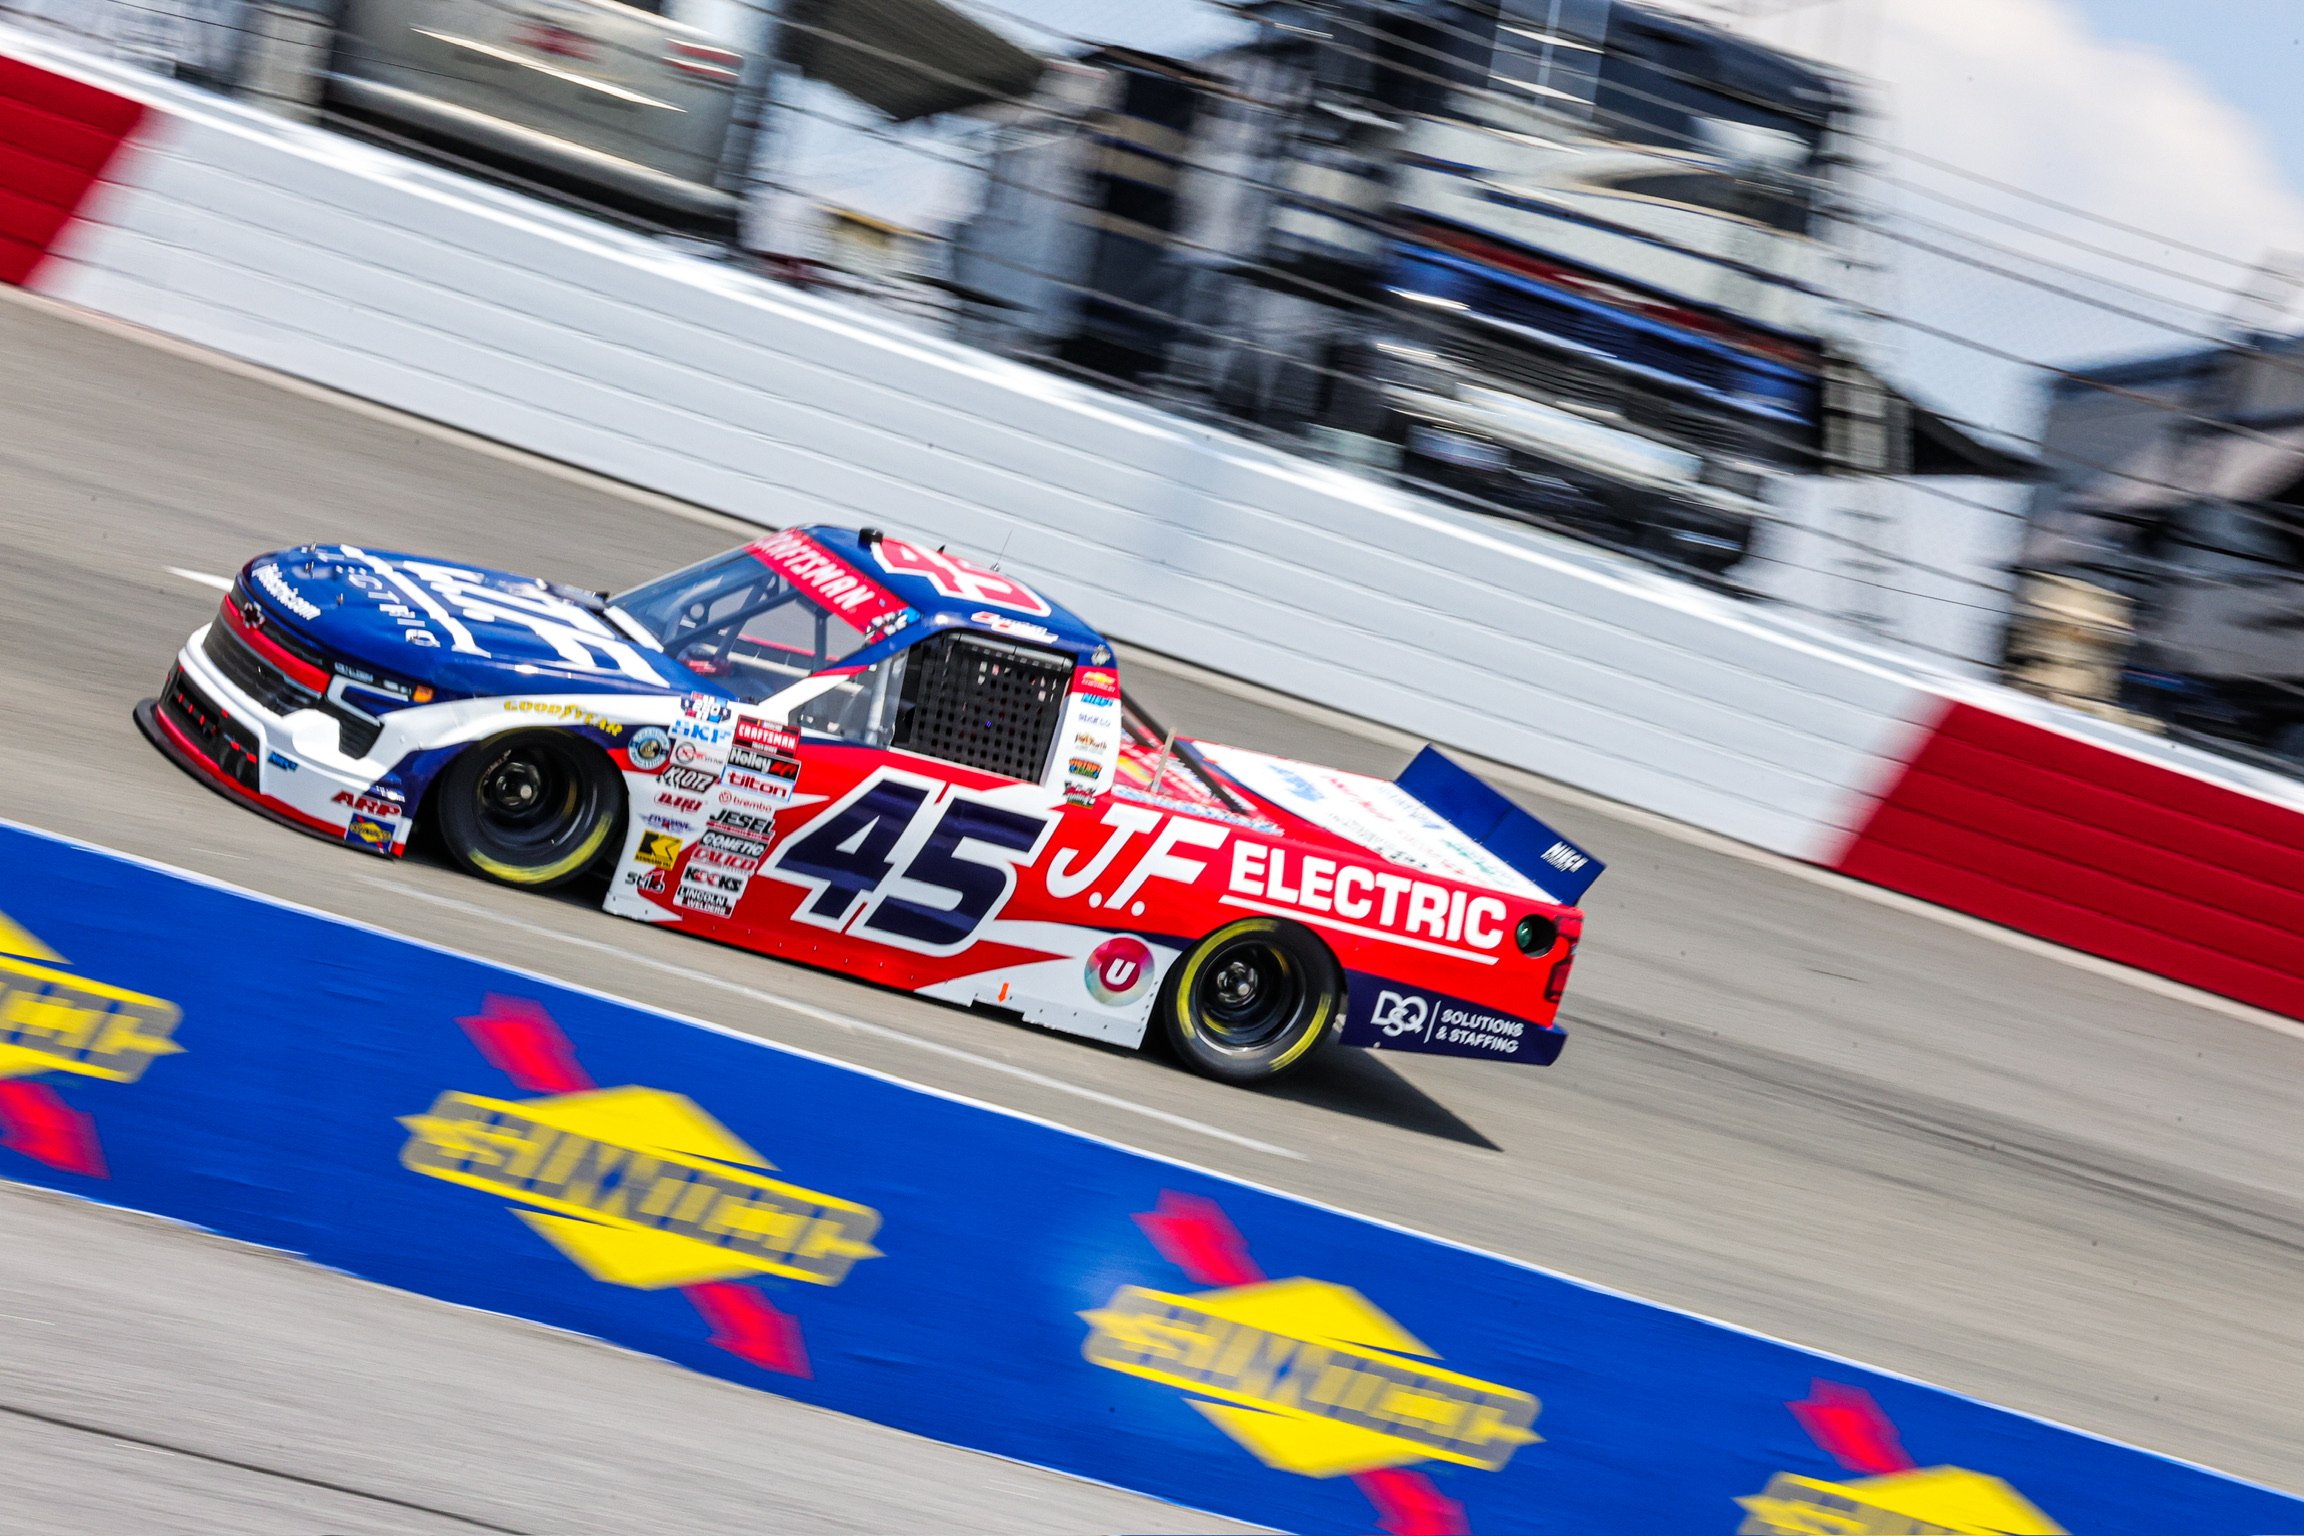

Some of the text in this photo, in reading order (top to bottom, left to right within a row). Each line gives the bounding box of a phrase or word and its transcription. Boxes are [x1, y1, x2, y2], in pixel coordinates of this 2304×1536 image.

[503, 700, 624, 738] GOODYEAR
[738, 723, 797, 751] CRAFTSMAN
[729, 747, 772, 775] Holley
[662, 766, 715, 792] KLOTZ
[728, 771, 789, 798] tilton
[331, 790, 402, 817] ARP
[732, 795, 774, 814] brembo
[709, 808, 776, 834] JESEL
[756, 764, 1065, 958] 45
[684, 865, 743, 893] KOOKS
[679, 885, 728, 907] LINCOLN
[684, 897, 727, 917] WELDERS
[1228, 839, 1508, 950] ELECTRIC
[1104, 957, 1137, 986] U
[1440, 1008, 1526, 1038] SOLUTIONS
[1434, 1025, 1520, 1054] & STAFFING
